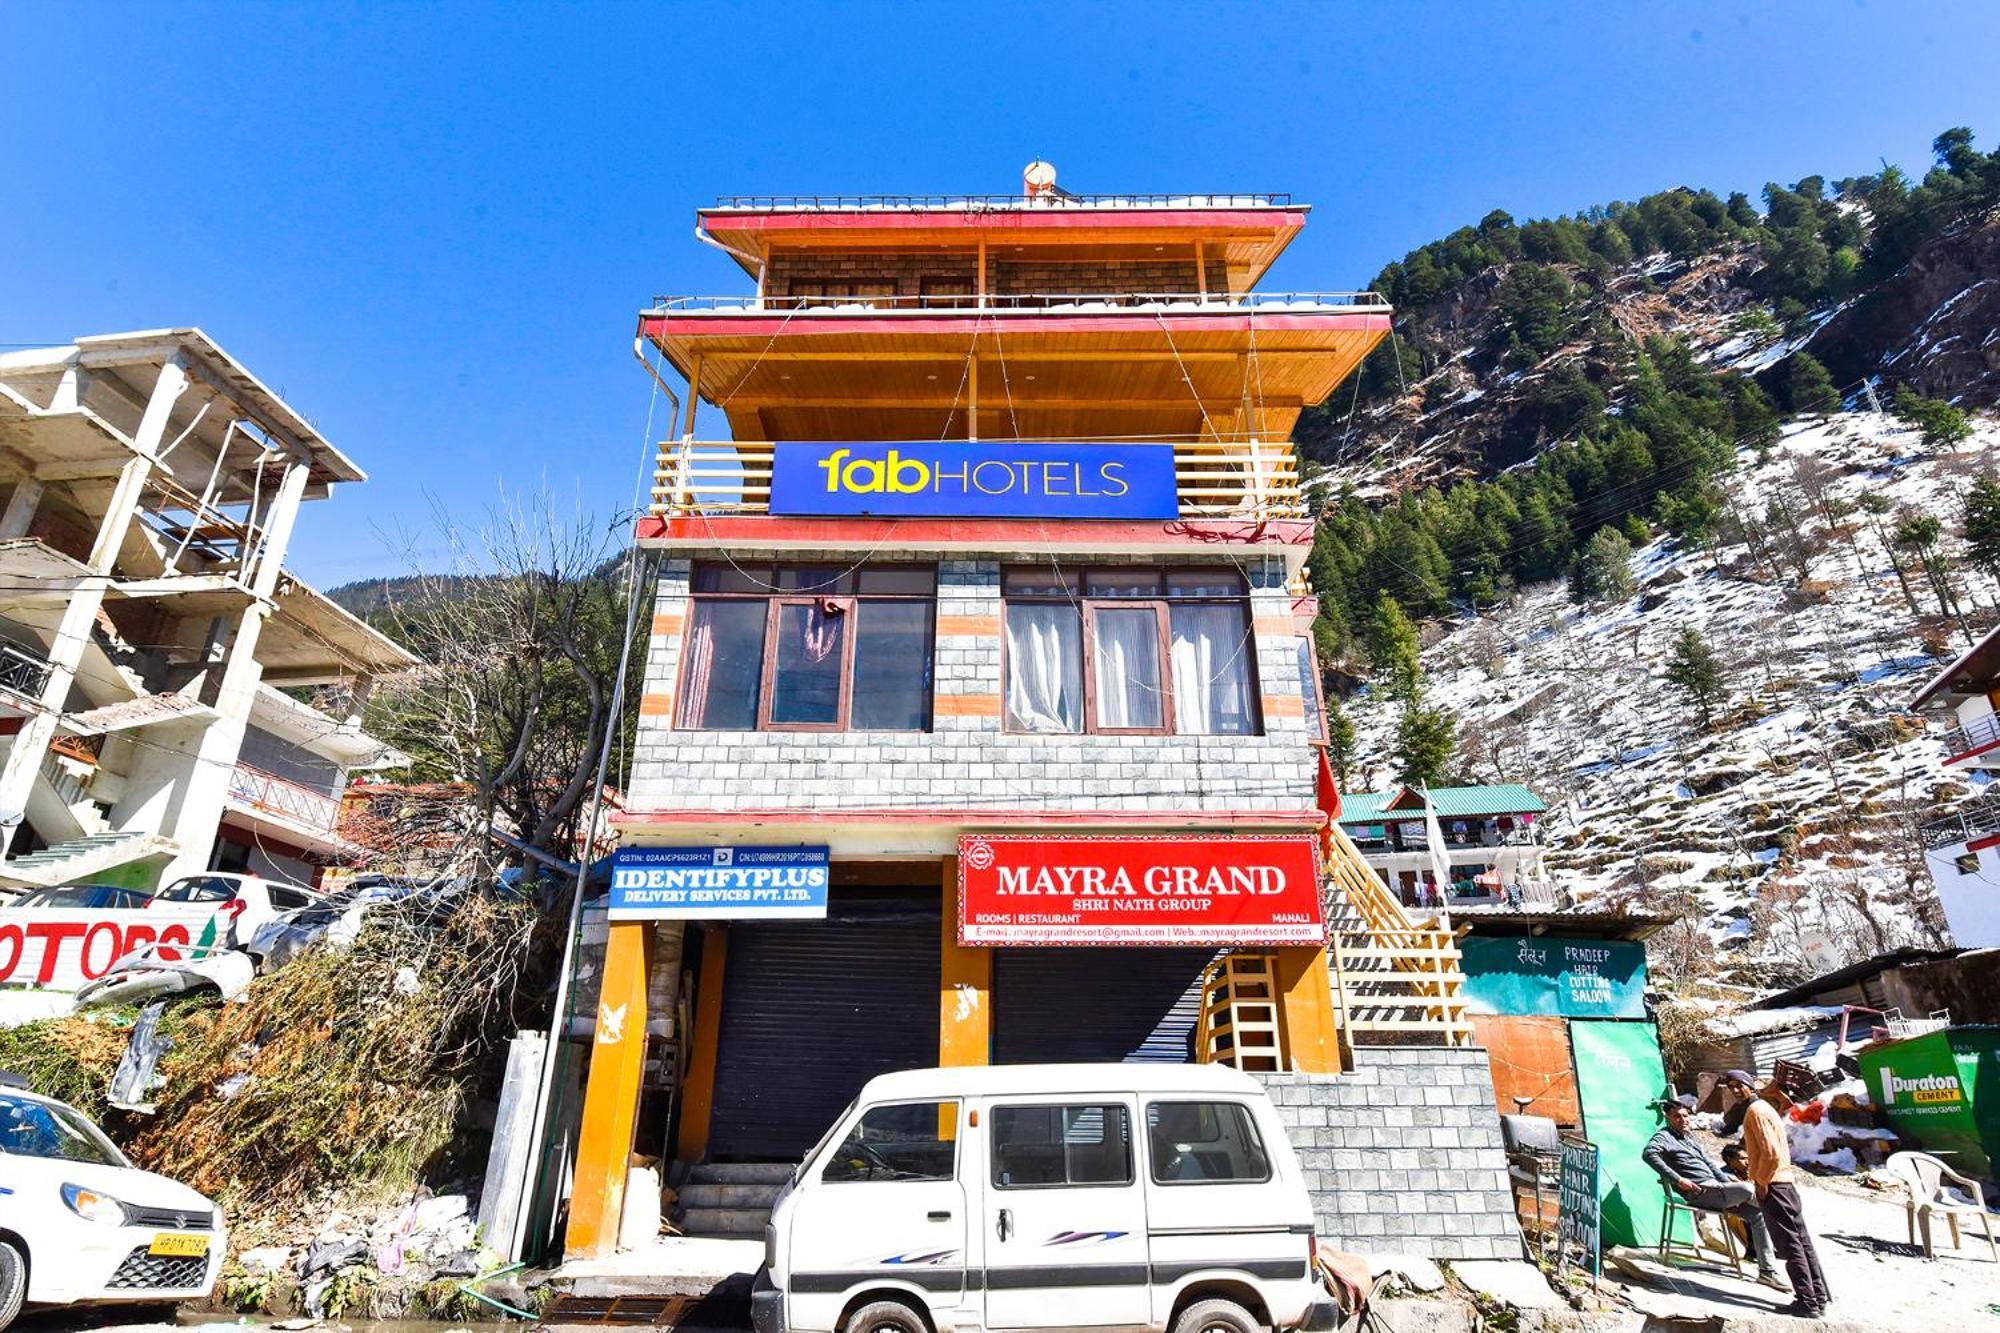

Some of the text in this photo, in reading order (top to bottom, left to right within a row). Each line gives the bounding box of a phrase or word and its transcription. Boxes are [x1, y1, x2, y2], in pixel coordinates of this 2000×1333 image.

[614, 868, 826, 889] IDENTIFYPLUS
[995, 866, 1287, 896] MAYRA GRAND
[623, 888, 811, 903] DELIVERY SERVICES PVT. LTD.
[1072, 898, 1212, 912] SHRI NATH GROUP
[976, 914, 1081, 924] ROOMS RESTAURANT
[1272, 914, 1311, 924] MANALI
[1564, 946, 1611, 963] PRADEEP
[1569, 977, 1611, 988] CUTTING
[1571, 989, 1612, 1003] SALOON
[1892, 1073, 1959, 1093] Duraton
[1916, 1090, 1955, 1101] CEMENT
[1564, 1167, 1590, 1193] HAIR
